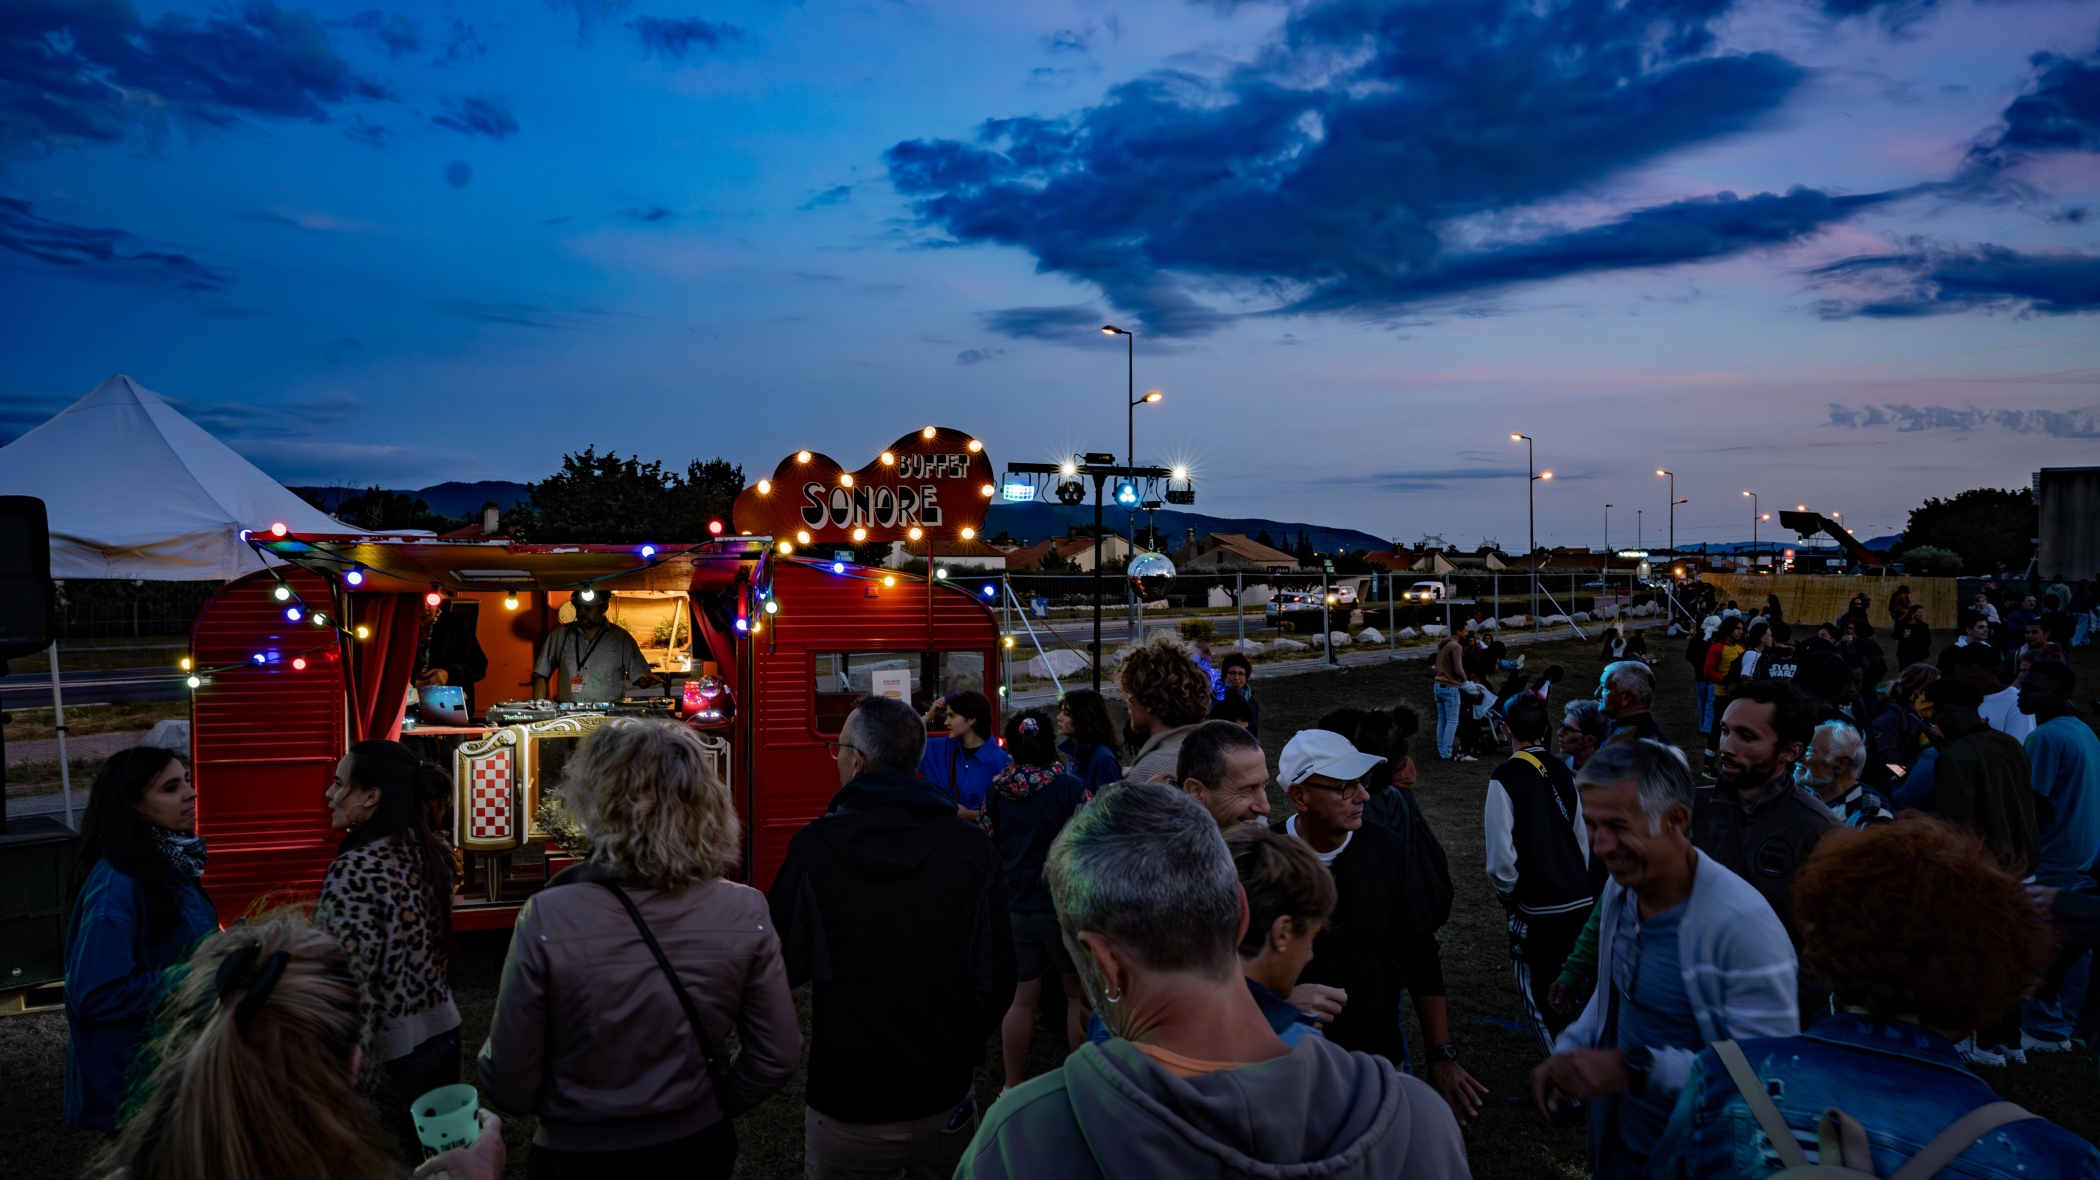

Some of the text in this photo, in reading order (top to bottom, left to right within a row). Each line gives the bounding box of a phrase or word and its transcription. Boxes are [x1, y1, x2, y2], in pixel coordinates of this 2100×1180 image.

[899, 454, 970, 479] BUFFET
[801, 482, 943, 530] SONORE
[1769, 669, 1796, 678] WARS
[1770, 664, 1797, 672] STAR
